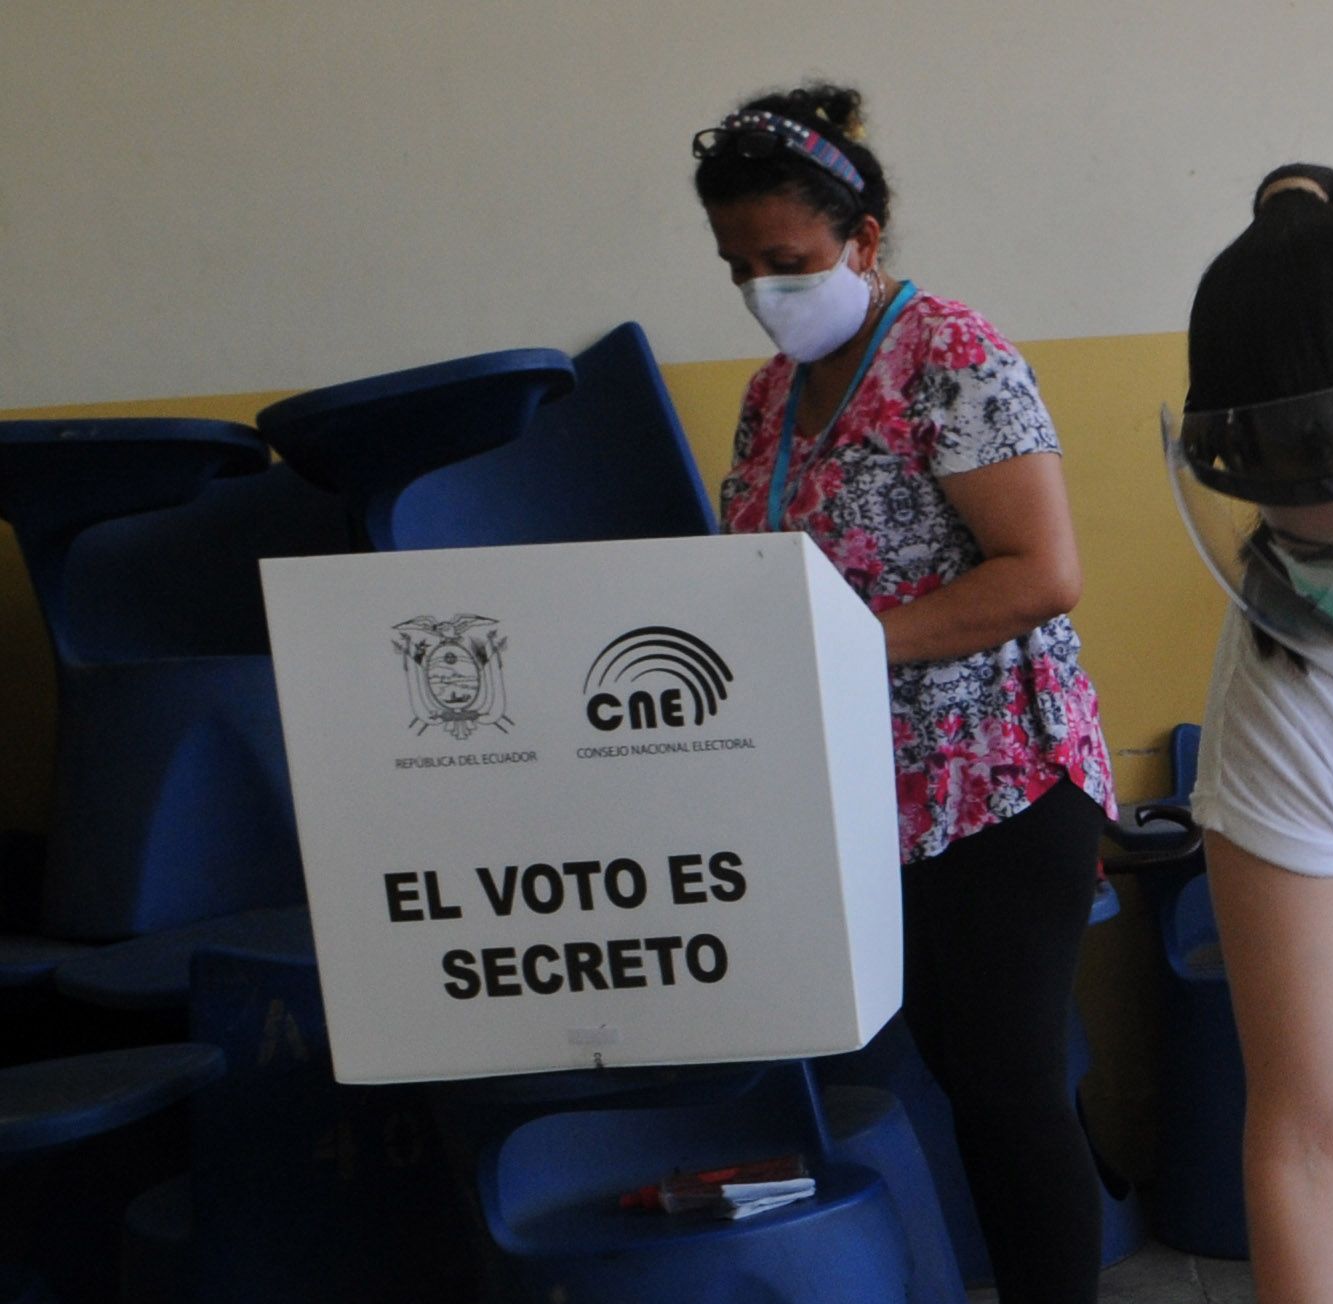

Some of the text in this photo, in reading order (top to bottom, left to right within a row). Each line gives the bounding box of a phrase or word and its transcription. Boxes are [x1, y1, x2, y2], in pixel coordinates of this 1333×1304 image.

[395, 751, 538, 770] REPÚBLICA DEL ECUADOR
[576, 738, 756, 760] CONSEJO NACIONAL ELECTORAL
[384, 851, 747, 923] EL VOTO ES
[442, 933, 729, 1000] SECRETO
